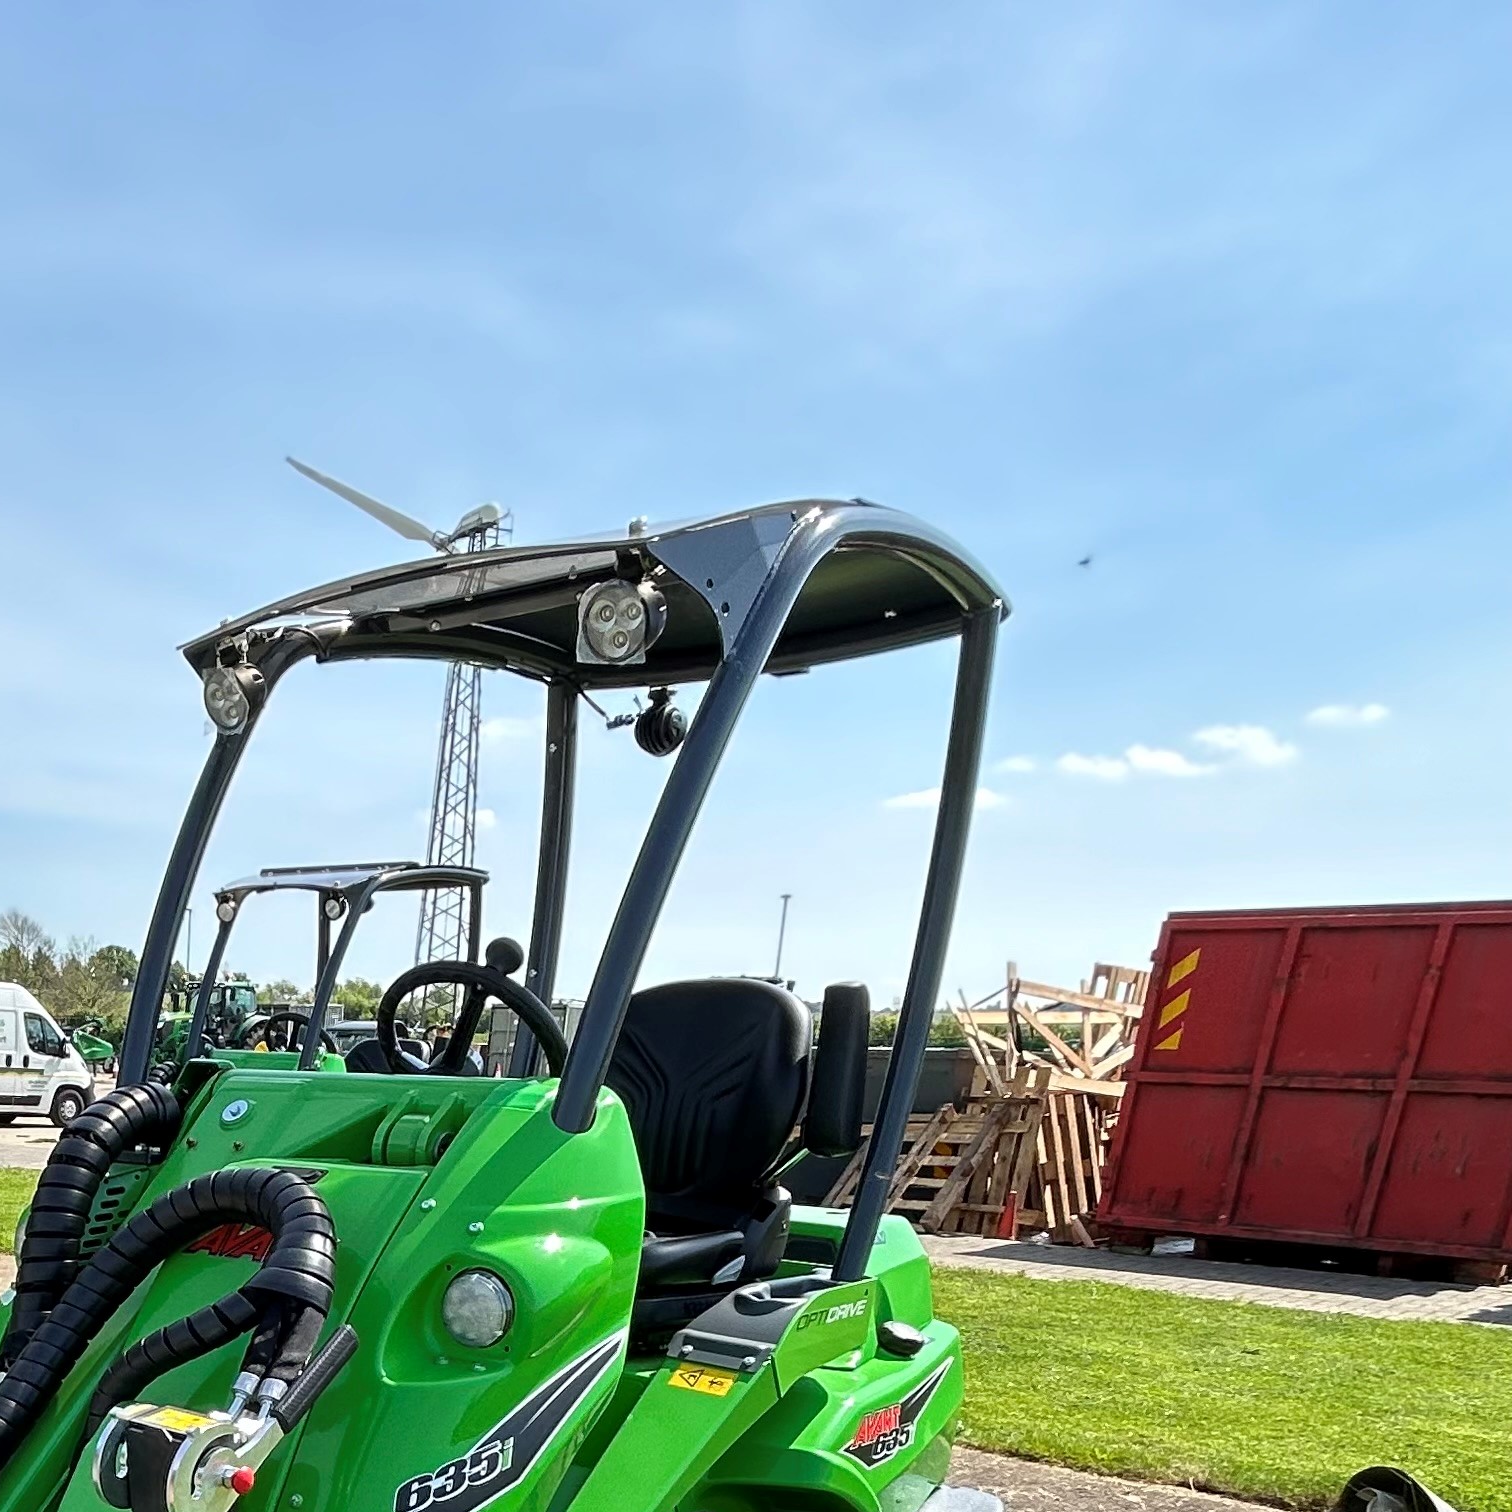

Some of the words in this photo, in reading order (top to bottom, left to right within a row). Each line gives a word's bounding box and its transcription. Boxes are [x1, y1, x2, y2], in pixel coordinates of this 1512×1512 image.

[182, 1222, 274, 1263] AVA
[796, 1299, 868, 1331] OPTIDRIVE
[849, 1403, 901, 1451] AVANT
